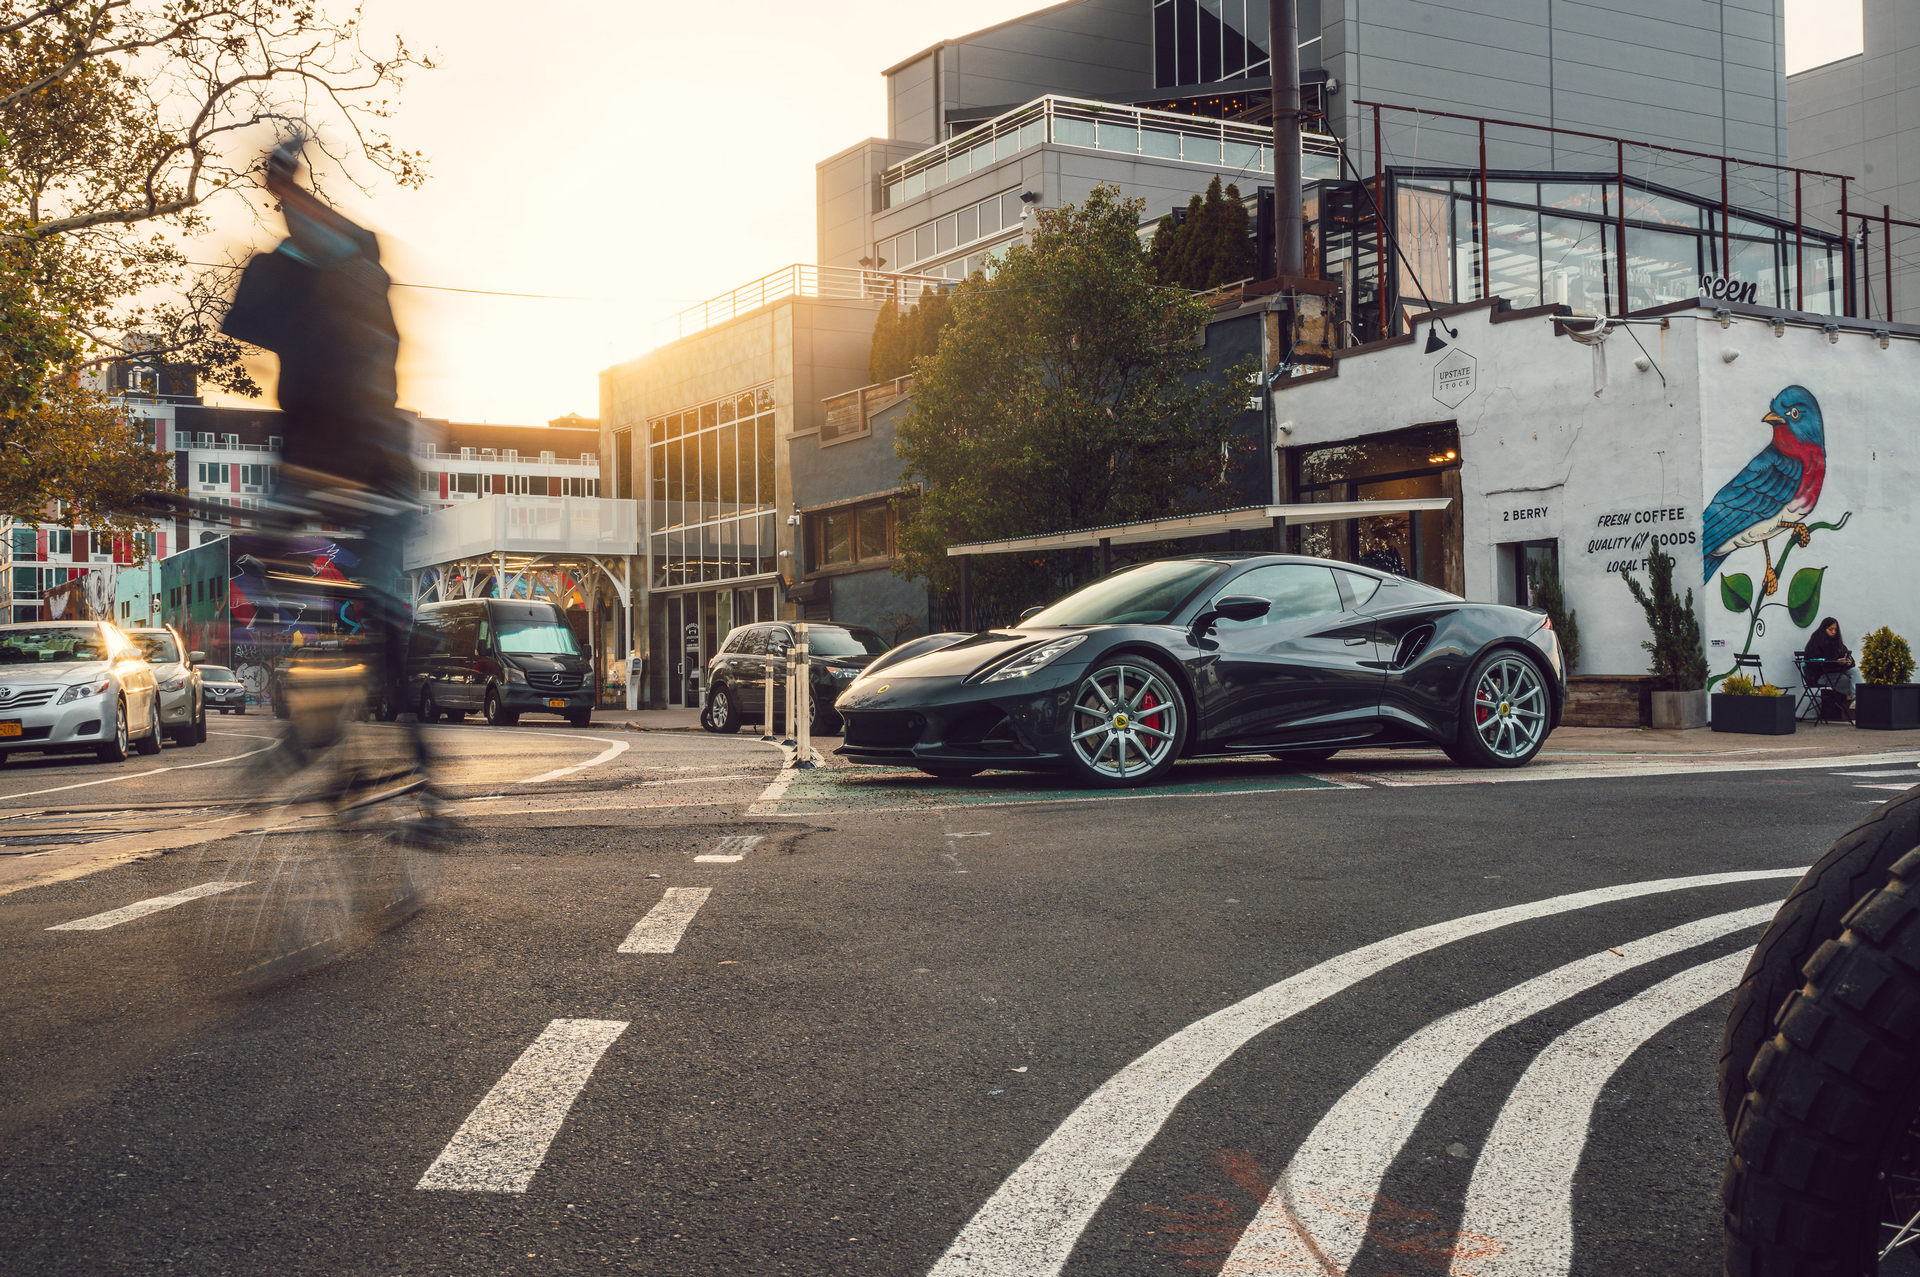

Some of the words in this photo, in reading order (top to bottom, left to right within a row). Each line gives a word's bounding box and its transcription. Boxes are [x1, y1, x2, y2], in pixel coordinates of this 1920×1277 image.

[1439, 367, 1471, 380] UPSTATE
[1439, 380, 1470, 391] STOCK
[1503, 511, 1510, 522] 2
[1513, 506, 1549, 521] BERRY
[1597, 513, 1632, 527] FRESH
[1635, 508, 1685, 524] COFFEE
[1587, 536, 1631, 554] QUALITY
[1606, 559, 1638, 573] LOCAL
[1641, 557, 1676, 571] FD
